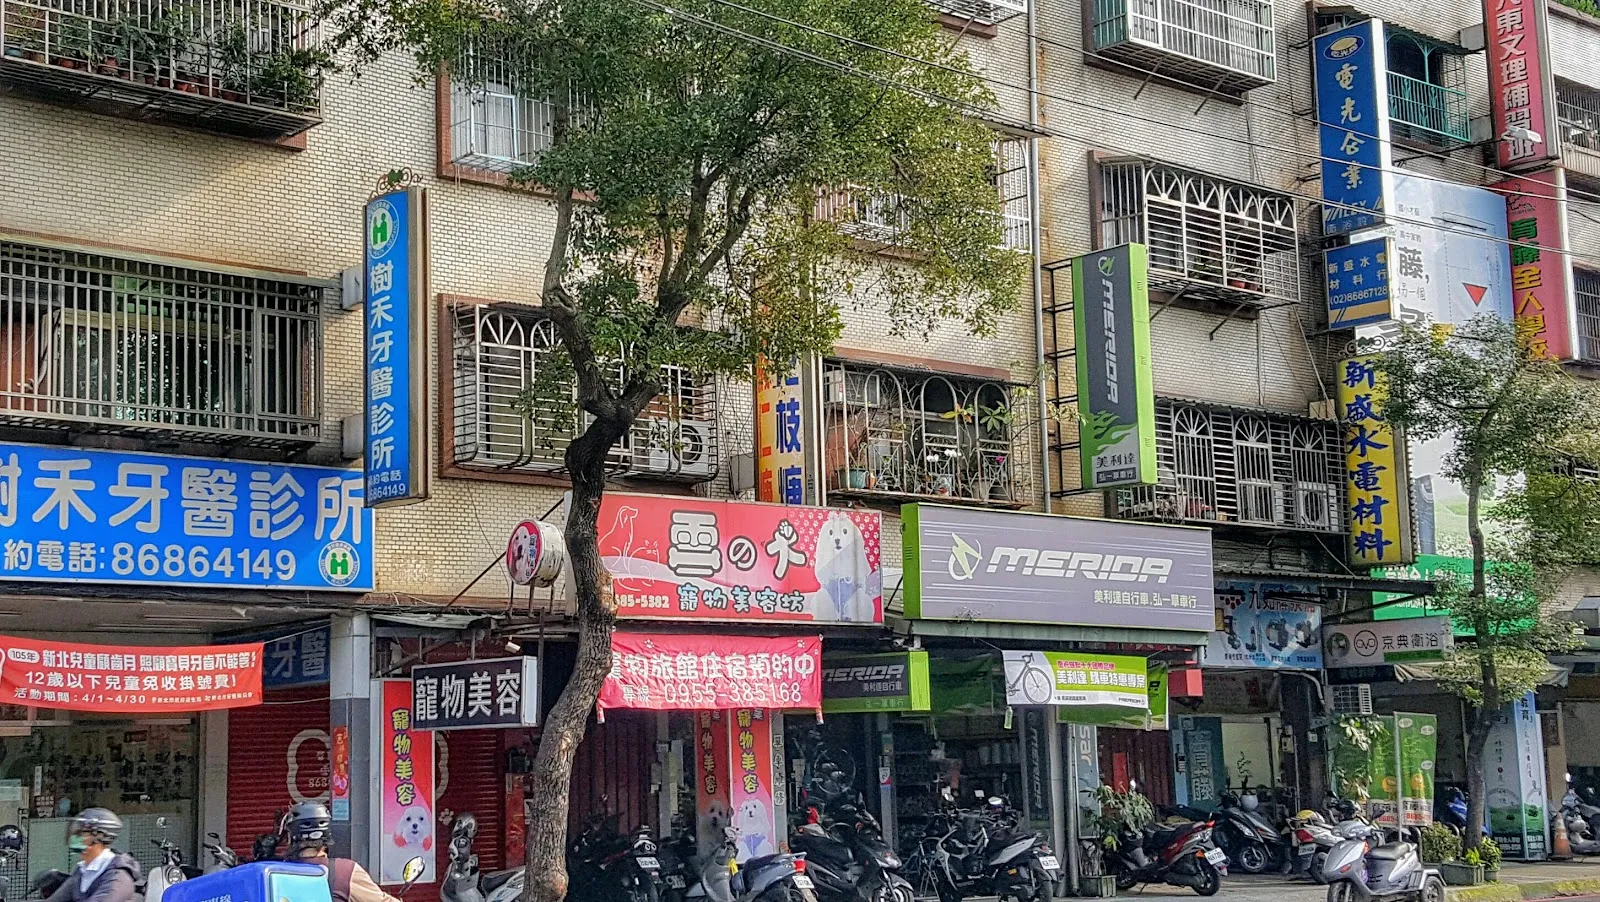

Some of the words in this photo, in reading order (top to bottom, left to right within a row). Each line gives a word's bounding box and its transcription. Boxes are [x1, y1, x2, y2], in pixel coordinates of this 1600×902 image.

[1335, 63, 1365, 189] 電光企業
[1329, 268, 1387, 290] 材料行
[370, 261, 395, 471] 樹禾牙醫診所
[1102, 279, 1119, 404] MERIDA
[1342, 360, 1393, 562] 新盛水電材料
[677, 583, 804, 613] 寵物美容坊
[985, 546, 1173, 584] MERIDA
[11, 651, 37, 661] 105年
[1381, 632, 1438, 650] 京典衛浴
[415, 668, 521, 722] 寵物美容
[391, 708, 416, 806] 寵物美容
[737, 708, 759, 794] 寵物美容
